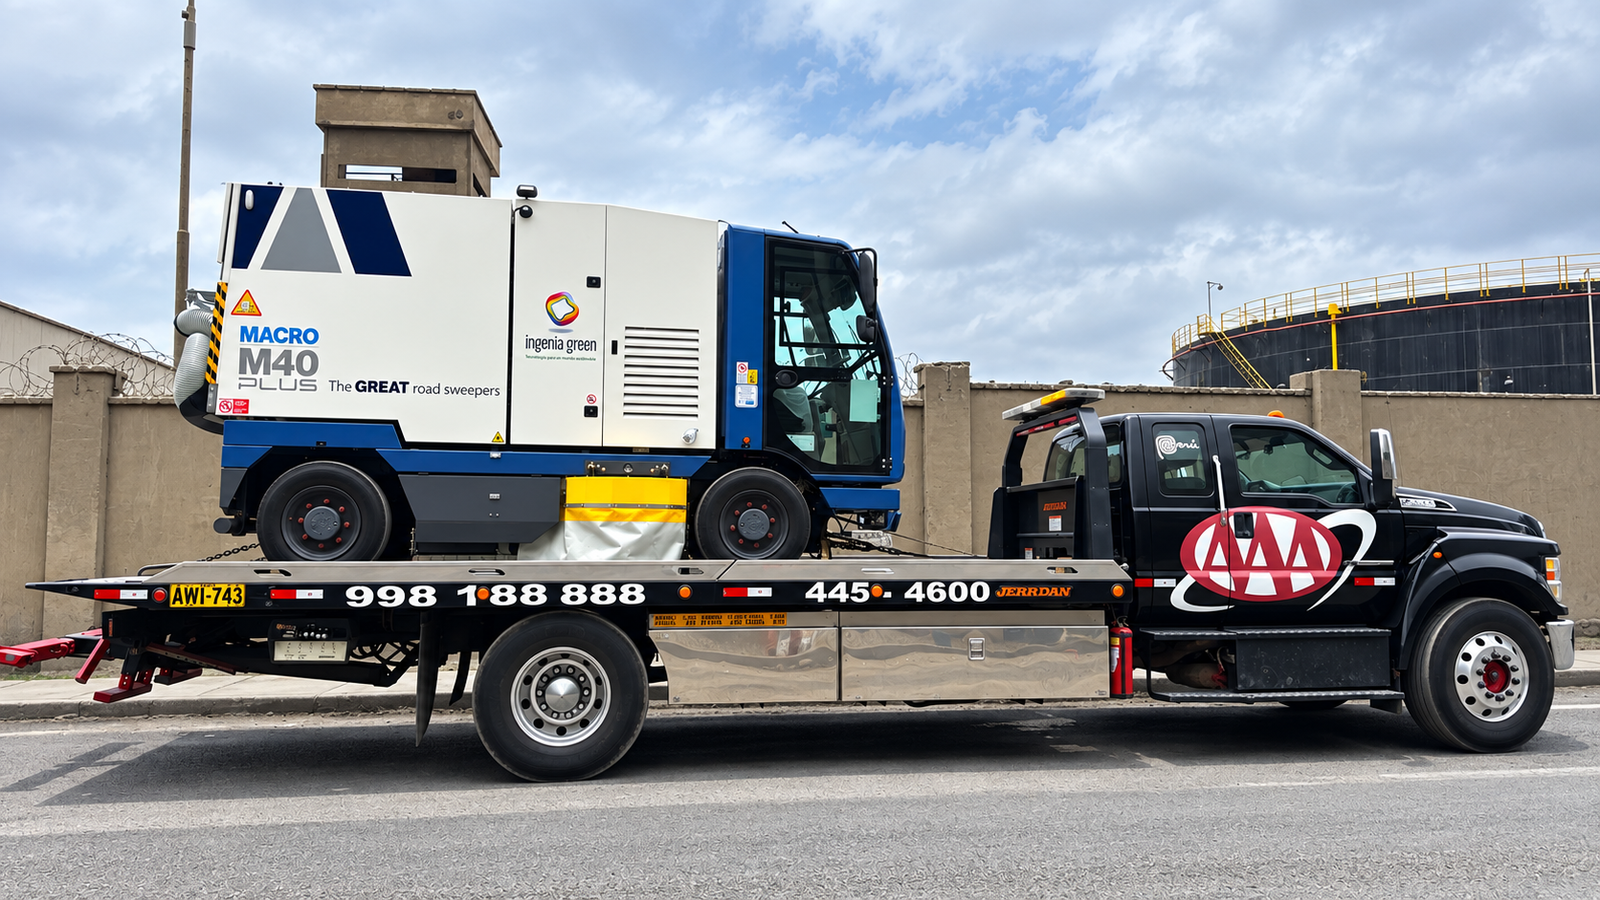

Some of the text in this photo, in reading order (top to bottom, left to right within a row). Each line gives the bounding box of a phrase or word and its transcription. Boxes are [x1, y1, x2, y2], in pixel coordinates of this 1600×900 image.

[240, 326, 319, 345] MACRO
[525, 334, 597, 354] ingenia green
[239, 348, 319, 377] M40
[238, 377, 317, 392] PLUS
[328, 380, 501, 398] The GREAT road sweepers
[1194, 511, 1333, 597] AAA
[172, 587, 243, 605] AWI-743
[345, 583, 646, 608] 998 188 888
[804, 581, 870, 603] 445
[904, 581, 991, 603] 4600
